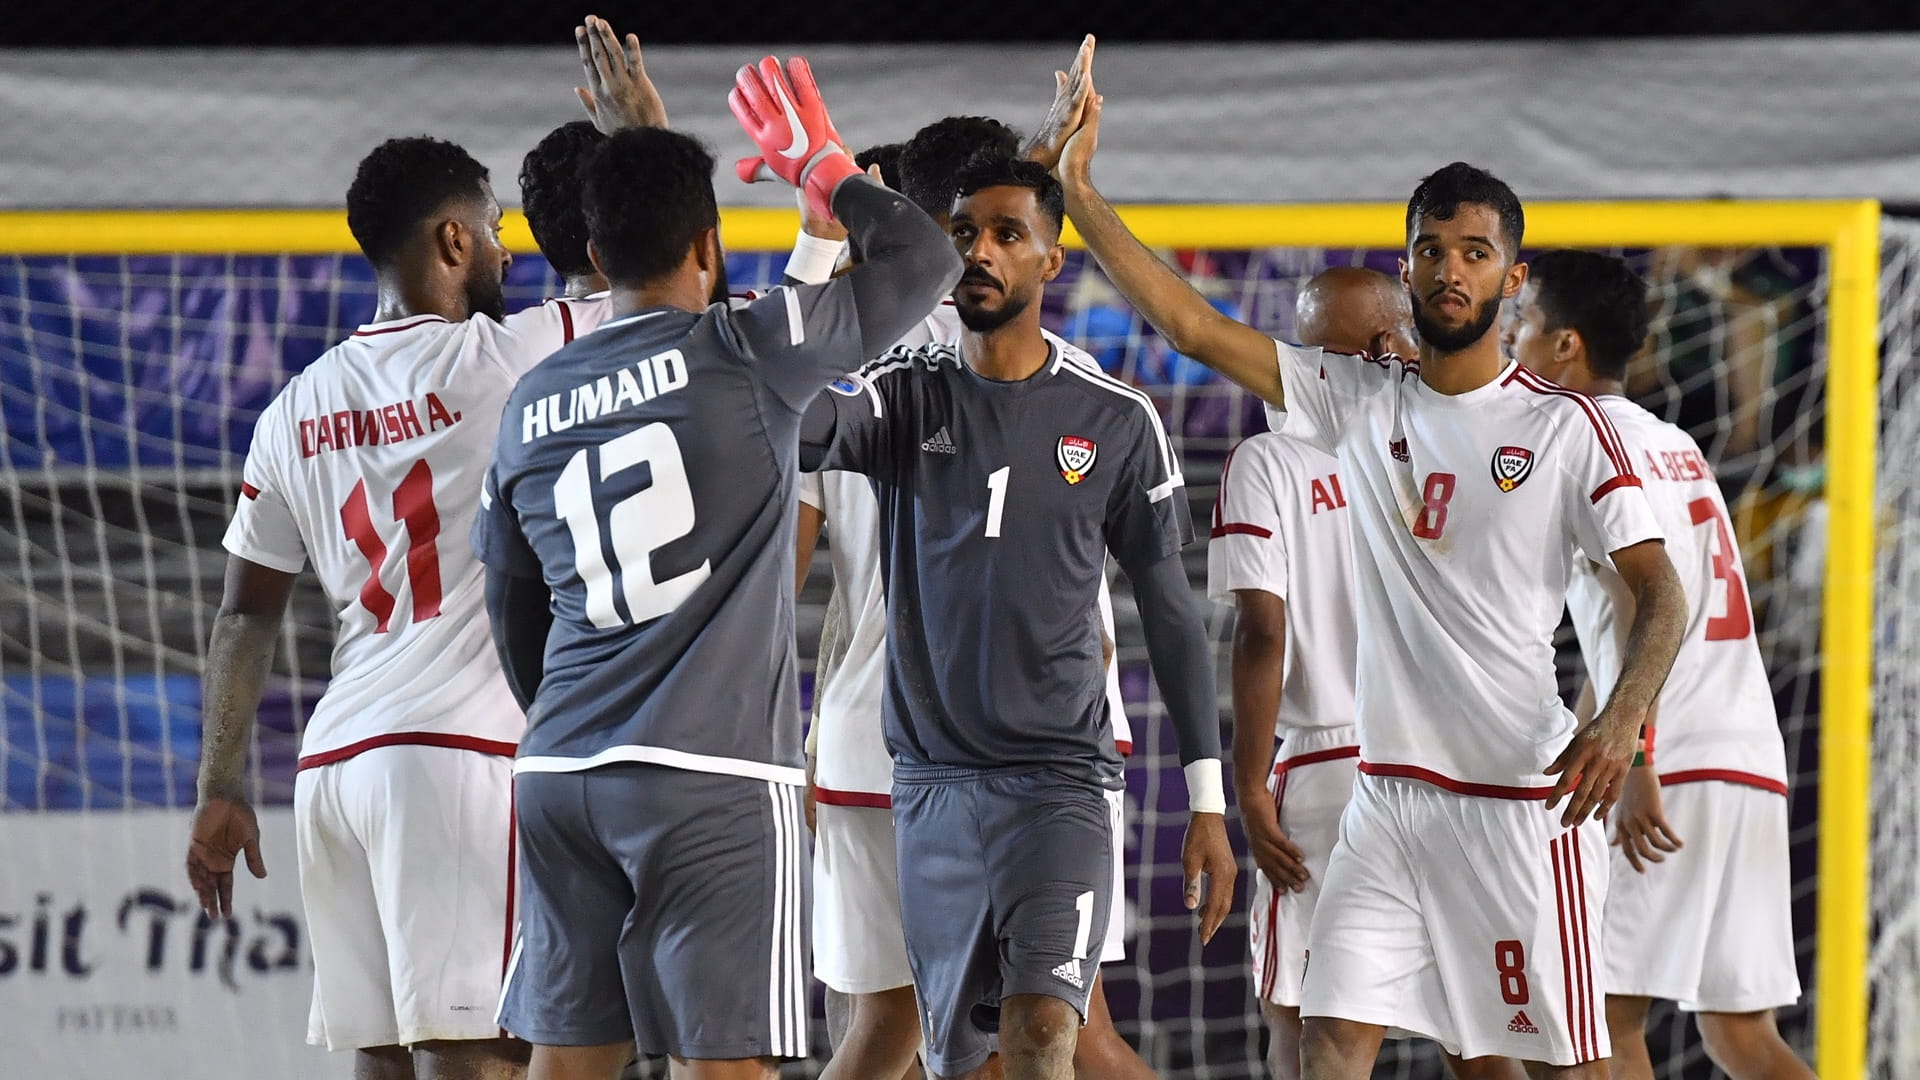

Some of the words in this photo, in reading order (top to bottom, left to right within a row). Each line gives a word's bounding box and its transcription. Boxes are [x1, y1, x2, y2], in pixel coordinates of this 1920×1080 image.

[299, 399, 424, 459] DARWISH
[425, 391, 462, 432] A.
[522, 348, 689, 444] HUMAID
[921, 442, 957, 455] adidas
[1066, 448, 1087, 459] UAE
[1070, 456, 1081, 465] FA
[1503, 457, 1523, 467] UAE
[1505, 464, 1516, 473] FA
[553, 421, 712, 629] 12
[984, 465, 1011, 538] 1
[1413, 472, 1456, 540] 8
[339, 458, 442, 634] 11
[1688, 496, 1750, 641] 3
[1072, 890, 1094, 959] 1
[1052, 967, 1084, 989] adidas
[1495, 940, 1530, 1005] 8
[1507, 1024, 1539, 1034] adidas
